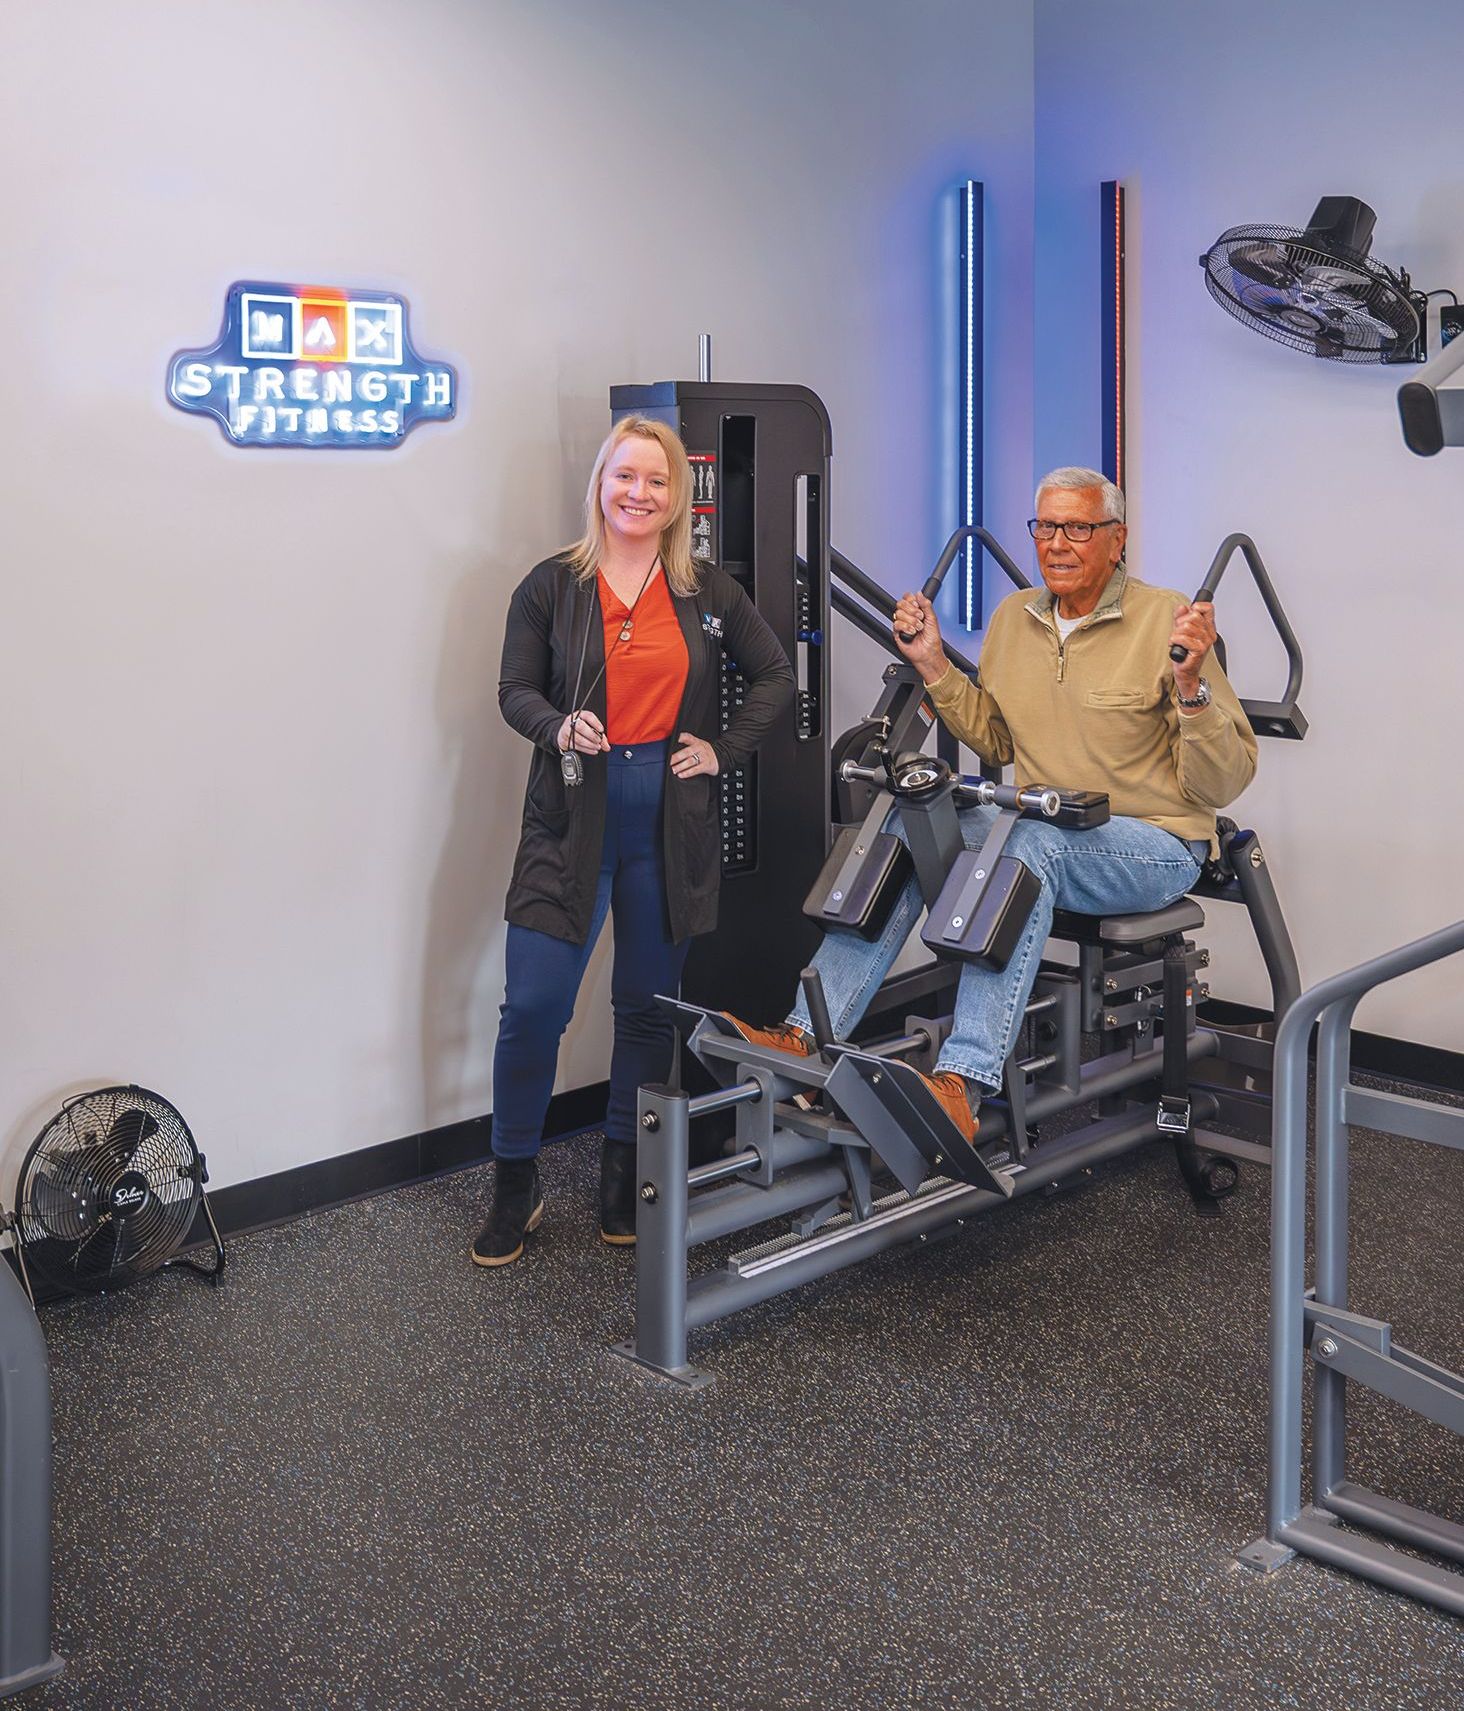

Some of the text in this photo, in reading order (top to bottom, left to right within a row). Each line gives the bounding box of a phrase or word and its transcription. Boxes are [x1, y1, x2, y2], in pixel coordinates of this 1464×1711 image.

[250, 308, 389, 350] MAX
[177, 363, 451, 406] STRENGTH
[235, 405, 400, 434] FITNESS
